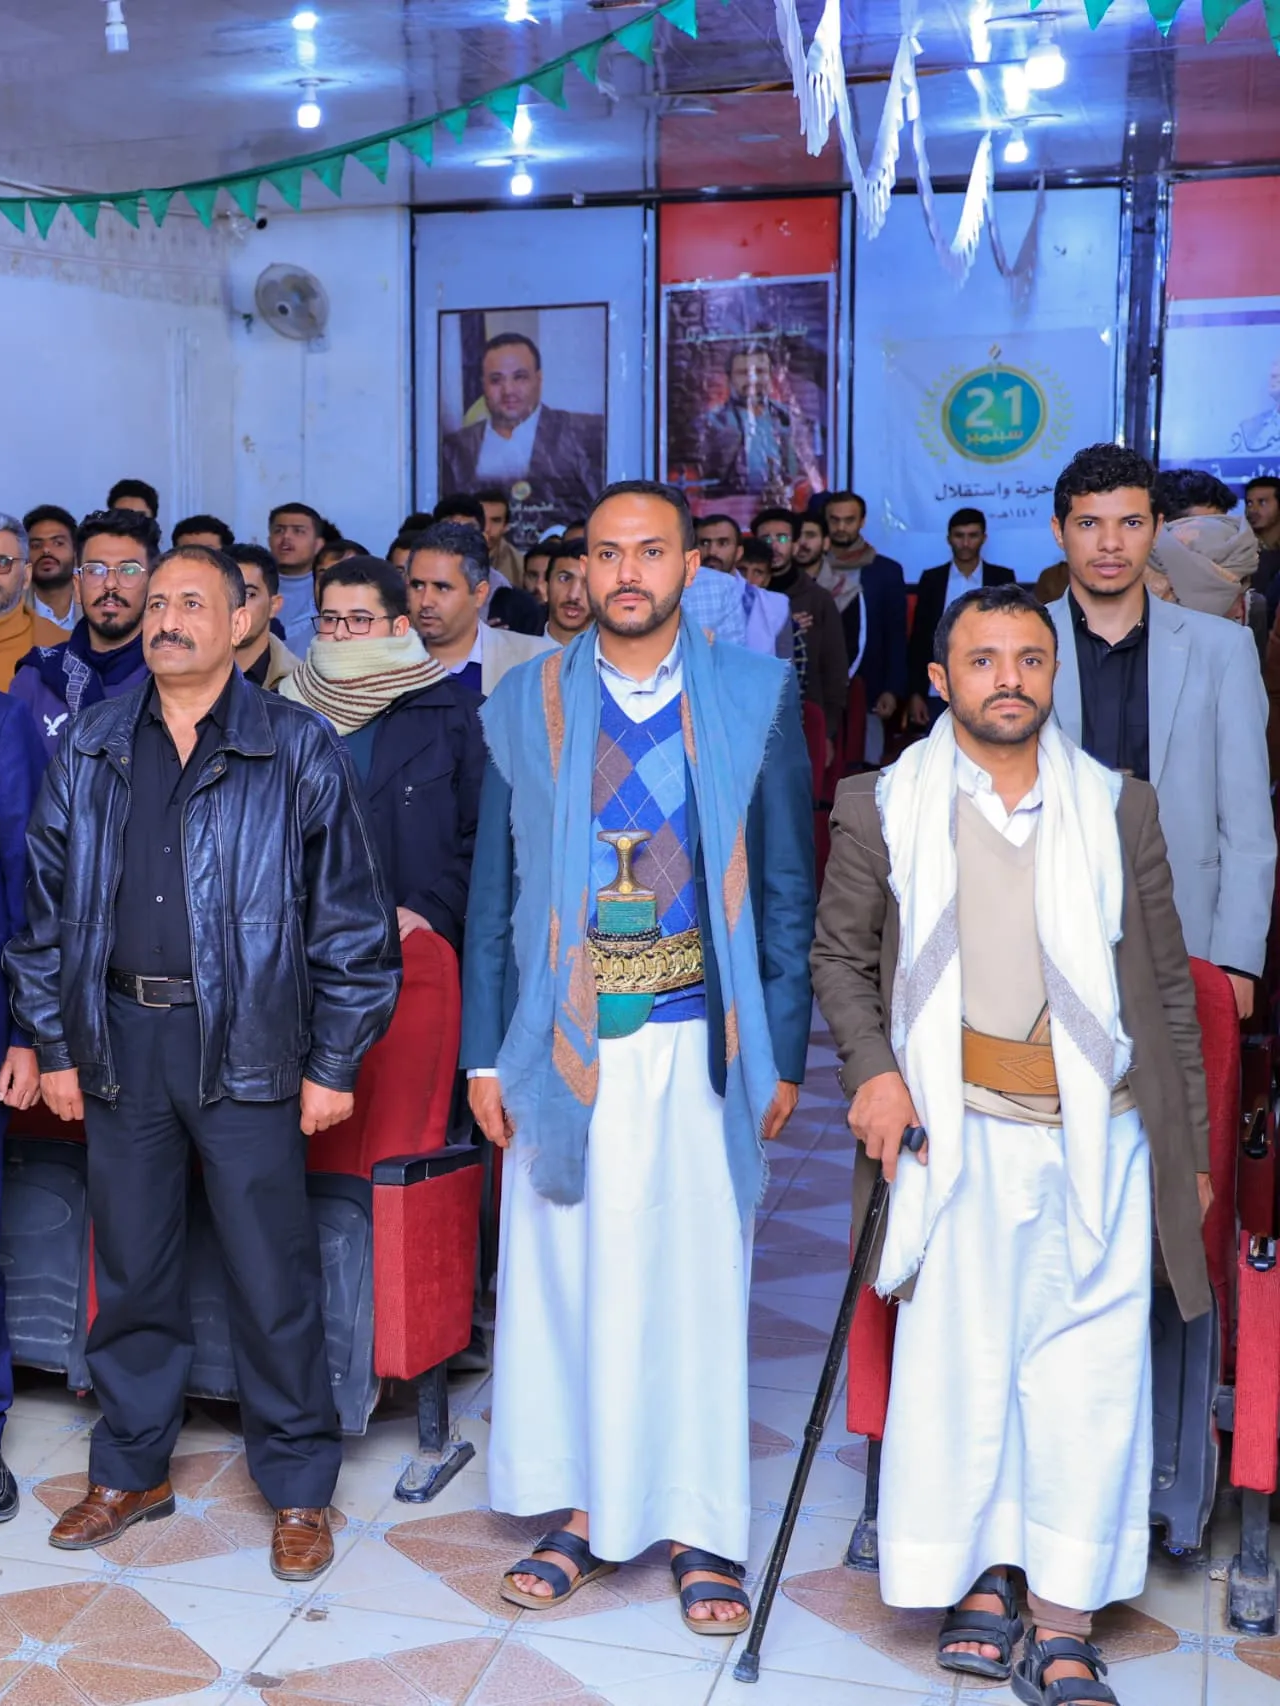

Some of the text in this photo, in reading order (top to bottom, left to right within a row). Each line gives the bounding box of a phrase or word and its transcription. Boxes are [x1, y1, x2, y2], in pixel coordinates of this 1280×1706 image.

[965, 385, 1023, 427] 21
[935, 480, 1054, 501] حرية واستقلال
